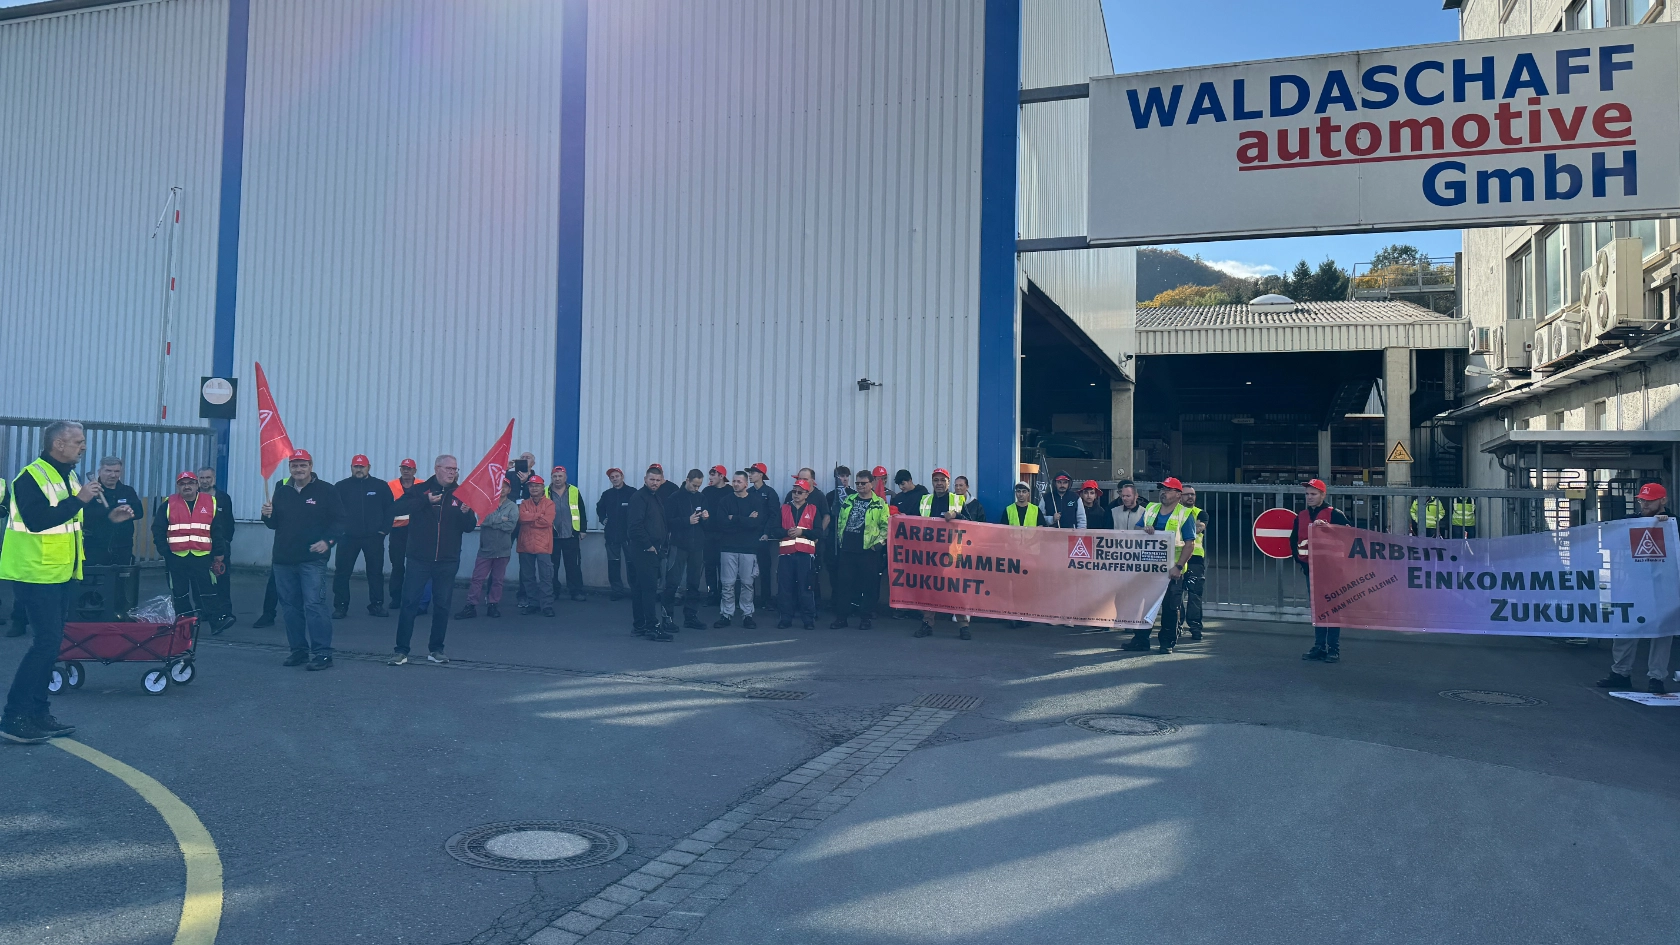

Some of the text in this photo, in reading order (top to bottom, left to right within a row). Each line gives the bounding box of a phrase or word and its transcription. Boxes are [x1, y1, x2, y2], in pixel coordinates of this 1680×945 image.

[1126, 43, 1635, 130] WALDASCHAFF
[1236, 96, 1633, 165] automotive
[1422, 150, 1638, 207] GmbH
[894, 521, 972, 546] ARBEIT.
[1095, 536, 1168, 550] ZUKUNFTS
[892, 545, 1029, 575] EINKOMMEN.
[1095, 549, 1141, 561] REGION
[1348, 537, 1458, 562] ARBEIT.
[1067, 559, 1168, 573] ASCHAFFENBURG
[1407, 566, 1608, 591] EINKOMMEN.
[892, 569, 991, 596] ZUKUNFT.
[1324, 571, 1376, 602] SOLIDARISCH
[1318, 574, 1399, 621] IST MAN NICHT ALLEINE!
[1490, 598, 1646, 624] ZUKUNFT.
